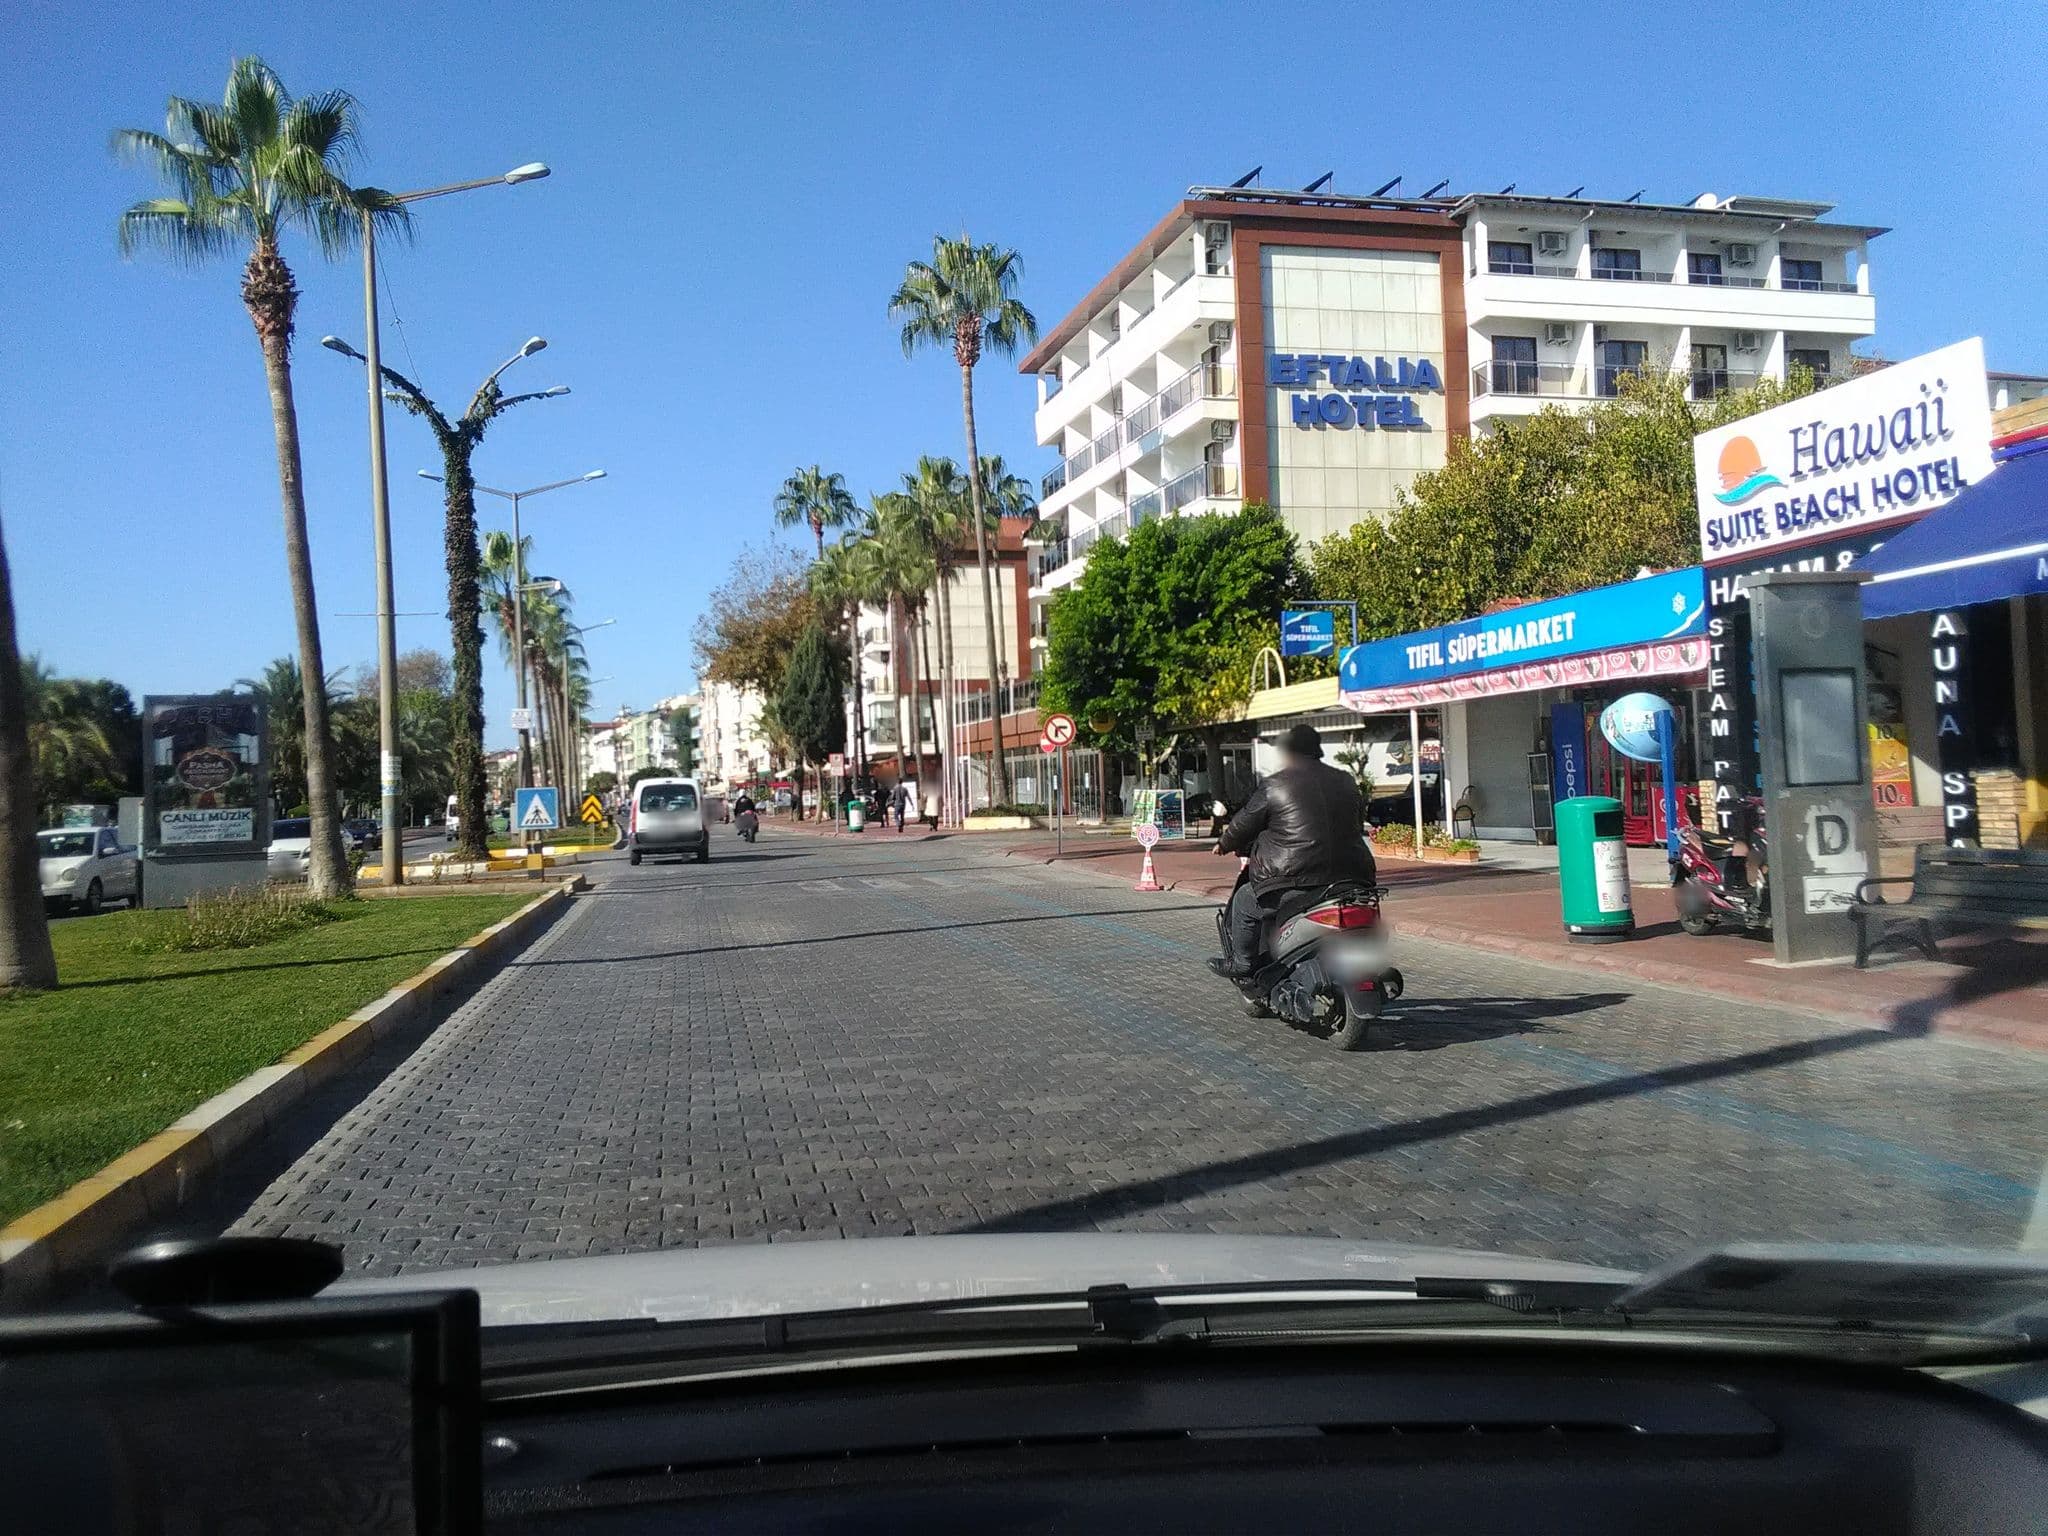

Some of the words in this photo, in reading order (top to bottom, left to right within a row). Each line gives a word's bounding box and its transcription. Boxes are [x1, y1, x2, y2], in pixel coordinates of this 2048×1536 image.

[1271, 354, 1439, 389] EFTALIA
[1292, 393, 1424, 426] HOTEL
[1789, 378, 1953, 478] Hawaii
[1707, 507, 1766, 546] SUITE
[1775, 481, 1861, 530] BEACH
[1872, 456, 1967, 507] HOTEL
[1300, 624, 1319, 633] TIFIL
[1406, 641, 1444, 669] TIFIL
[1447, 612, 1576, 664] SÜPERMARKET
[1709, 618, 1730, 737] STEAM
[1931, 614, 1961, 737] AUNA
[1876, 783, 1897, 803] 10
[162, 813, 205, 823] CANLI
[1815, 815, 1849, 856] D
